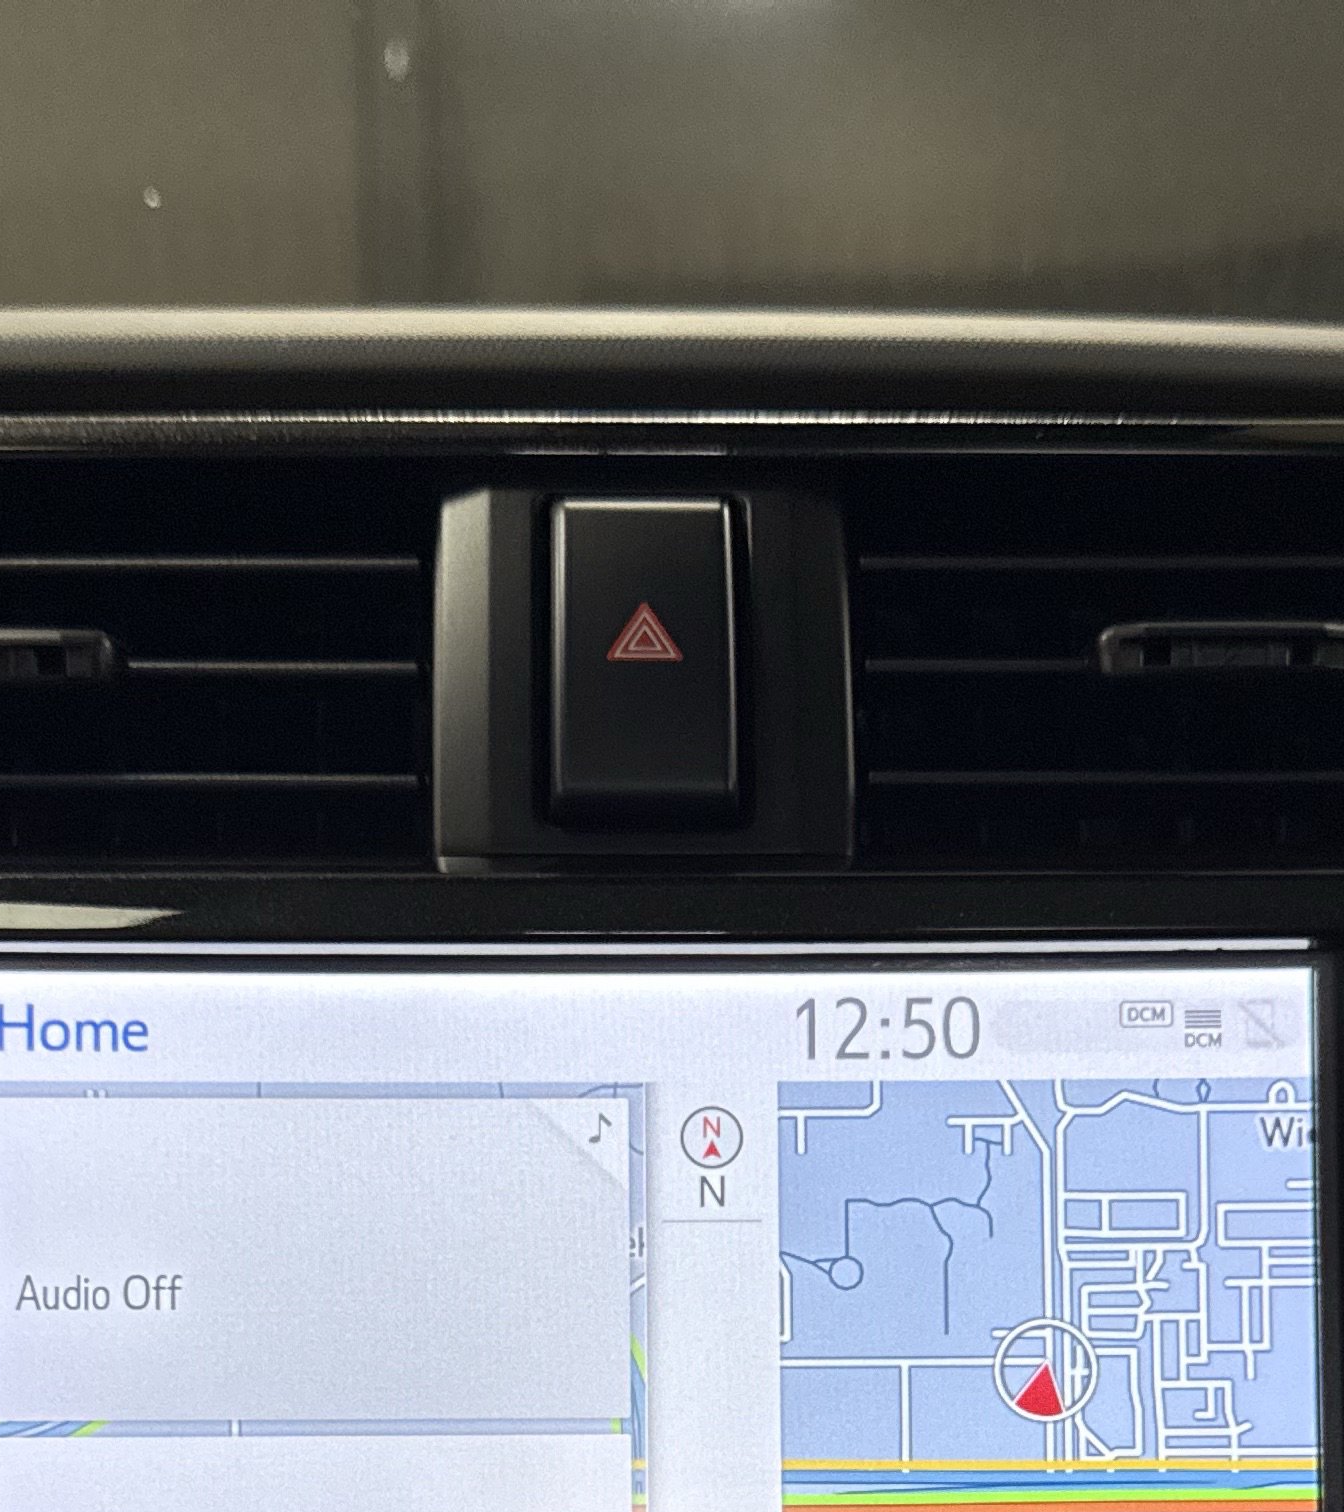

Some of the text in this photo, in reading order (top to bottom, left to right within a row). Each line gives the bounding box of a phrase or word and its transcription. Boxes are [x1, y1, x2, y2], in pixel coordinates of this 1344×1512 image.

[796, 996, 981, 1061] 12:50
[1127, 1007, 1166, 1022] DCM
[1184, 1033, 1222, 1048] DCM
[702, 1116, 721, 1139] N
[700, 1175, 725, 1208] N
[15, 1275, 183, 1311] Audio Off
